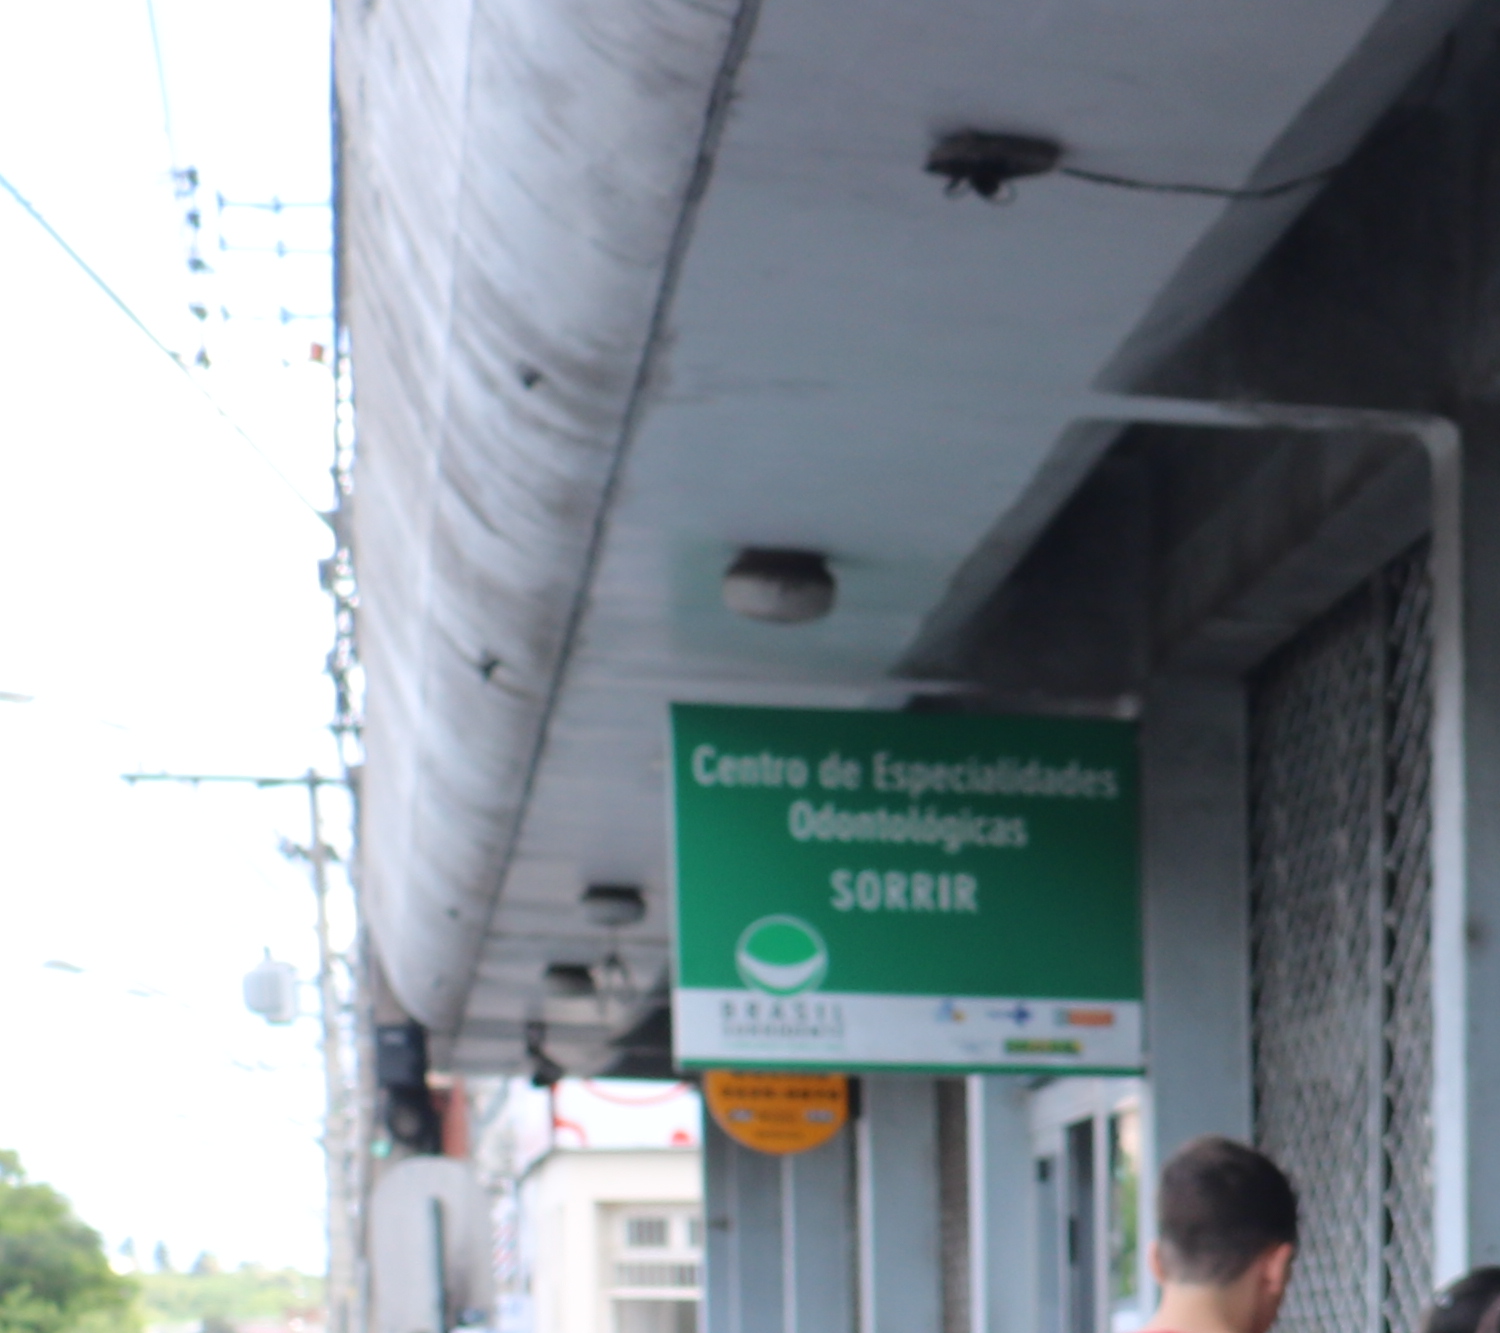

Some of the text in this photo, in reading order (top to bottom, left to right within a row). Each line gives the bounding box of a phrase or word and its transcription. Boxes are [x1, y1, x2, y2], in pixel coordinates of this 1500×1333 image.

[692, 745, 1118, 798] Centro de Especialidades
[788, 801, 1028, 853] Odontológicas
[829, 869, 979, 912] SORRIR
